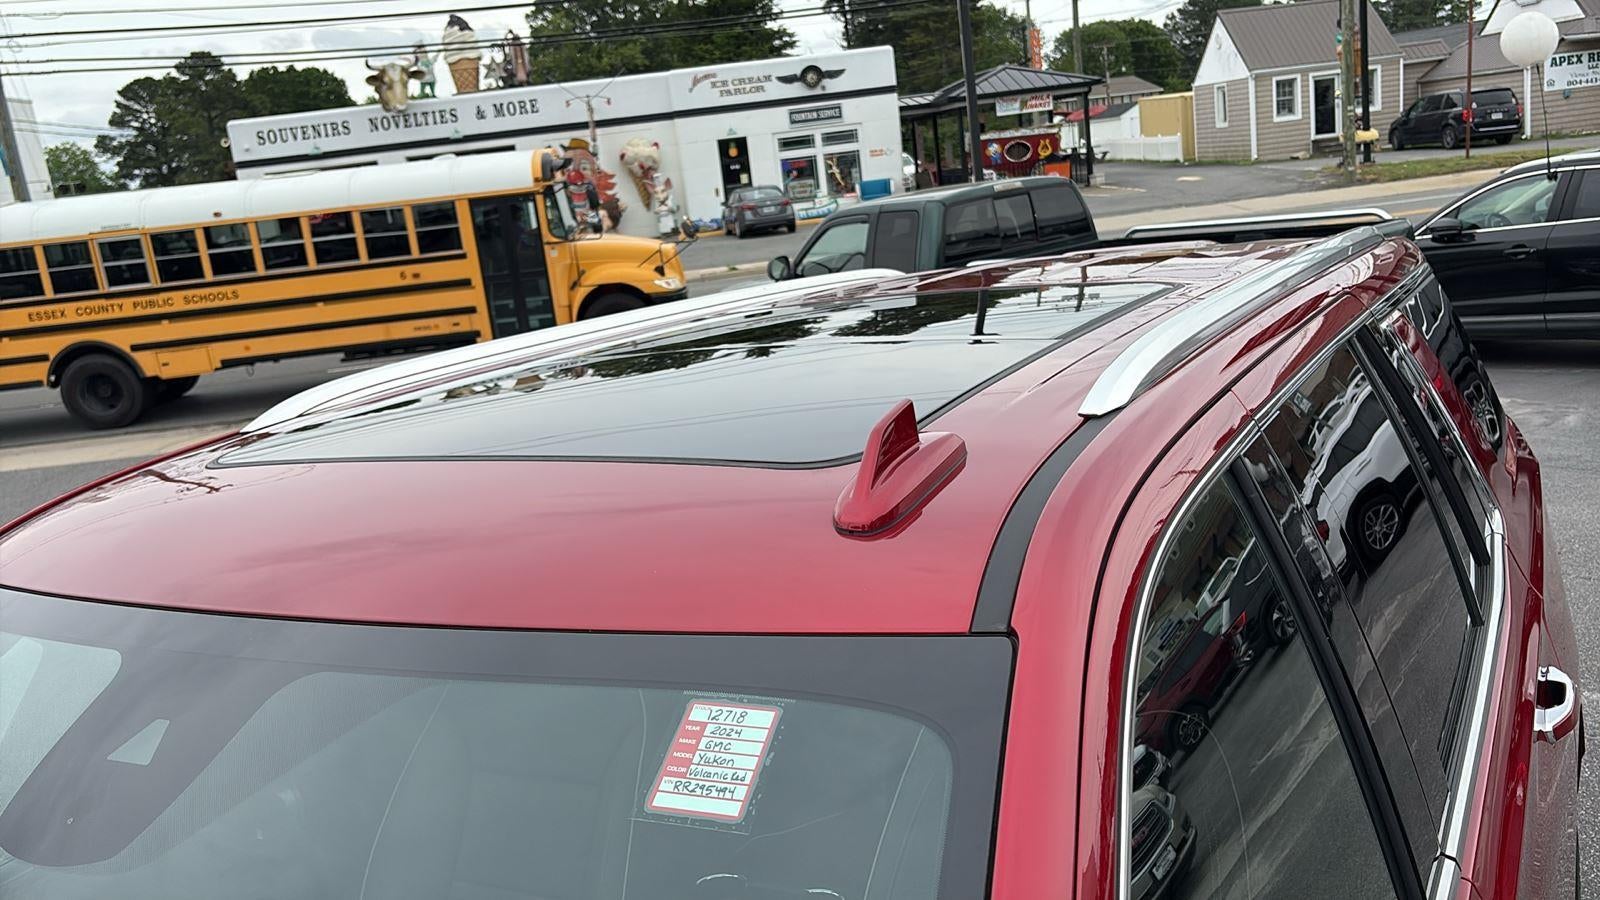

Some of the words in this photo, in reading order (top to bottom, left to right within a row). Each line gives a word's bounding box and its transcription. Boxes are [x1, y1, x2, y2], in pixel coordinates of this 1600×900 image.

[1550, 54, 1583, 67] APEX
[711, 80, 729, 89] ICE
[731, 75, 773, 87] CREAM
[719, 85, 766, 97] PARLOR
[256, 120, 351, 146] SOUVENIRS
[367, 108, 459, 129] NOVELTIES
[475, 105, 487, 120] &
[492, 99, 540, 118] MORE
[28, 308, 67, 322] ESSEX
[75, 303, 123, 317] COUNTY
[133, 297, 175, 311] PUBLIC
[183, 290, 240, 306] SCHOOLS
[707, 708, 748, 724] 12718
[685, 724, 701, 732] YEAR
[709, 726, 743, 738] 2024
[679, 737, 697, 745] MAKE
[705, 740, 732, 752] GMC
[673, 751, 694, 759] MODEL
[698, 753, 734, 767] Yukon
[666, 765, 687, 774] COLOR
[689, 767, 728, 780] Volcanic
[731, 771, 747, 783] Red
[673, 780, 737, 799] RR295494
